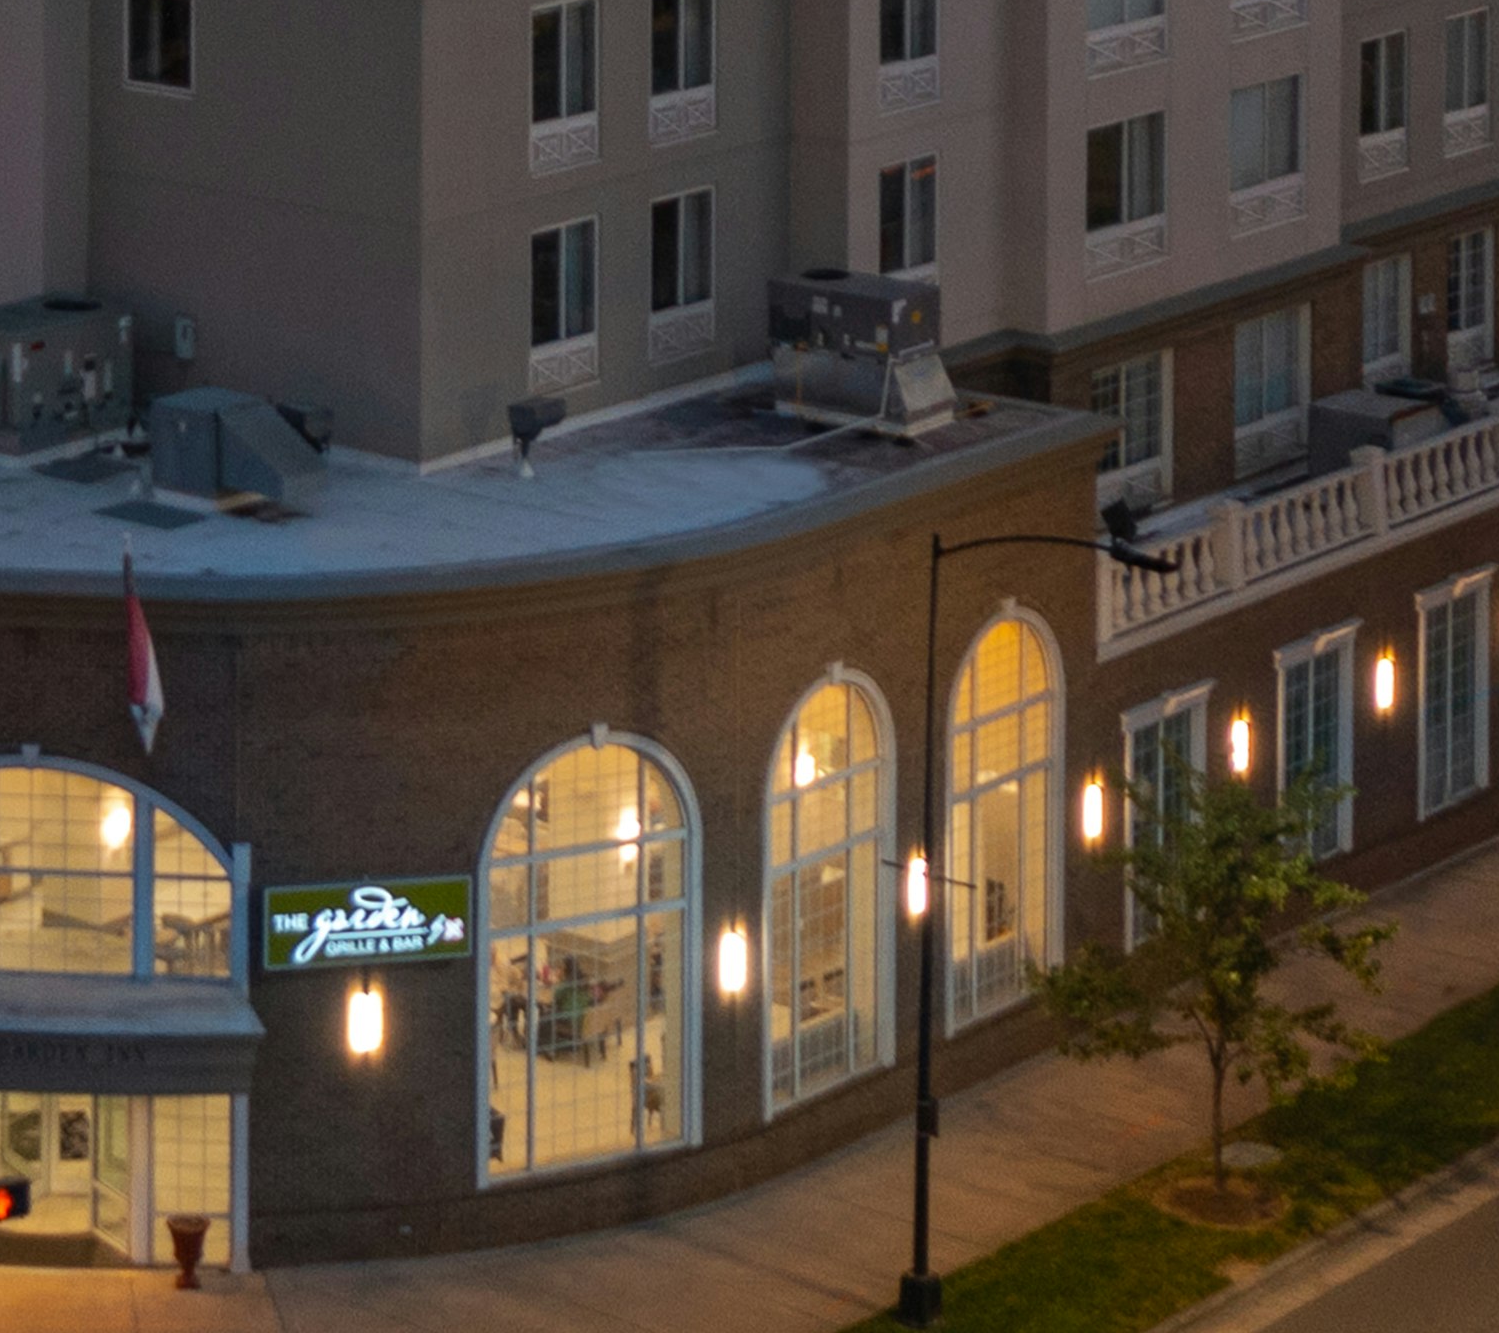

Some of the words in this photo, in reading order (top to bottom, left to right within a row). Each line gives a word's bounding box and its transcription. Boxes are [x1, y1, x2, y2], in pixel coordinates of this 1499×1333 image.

[272, 913, 309, 932] THE
[290, 886, 427, 964] garden
[323, 938, 376, 957] GRILLE
[392, 935, 425, 951] BAR
